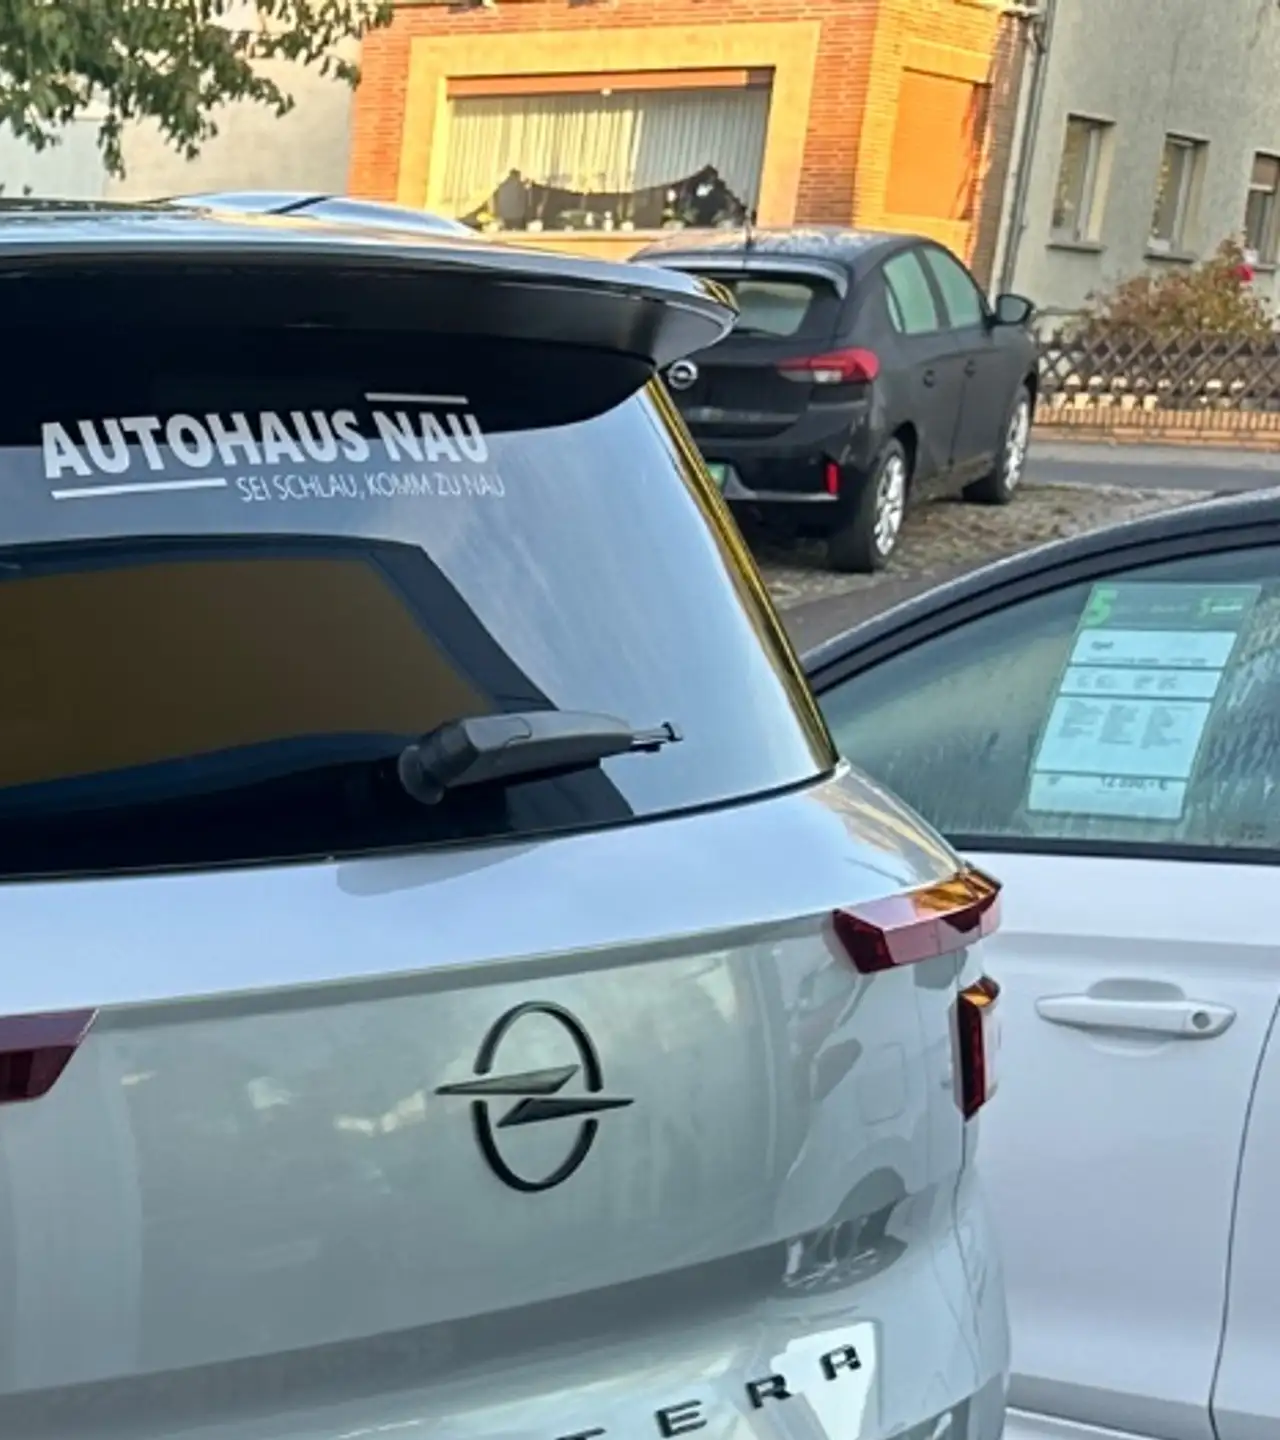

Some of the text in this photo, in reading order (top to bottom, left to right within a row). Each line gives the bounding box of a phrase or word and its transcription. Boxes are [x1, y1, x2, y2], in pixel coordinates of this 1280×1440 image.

[41, 409, 490, 479] AUTOHAUS NAU
[235, 471, 506, 502] SEI SCHLAU, KOMM ZU NAU
